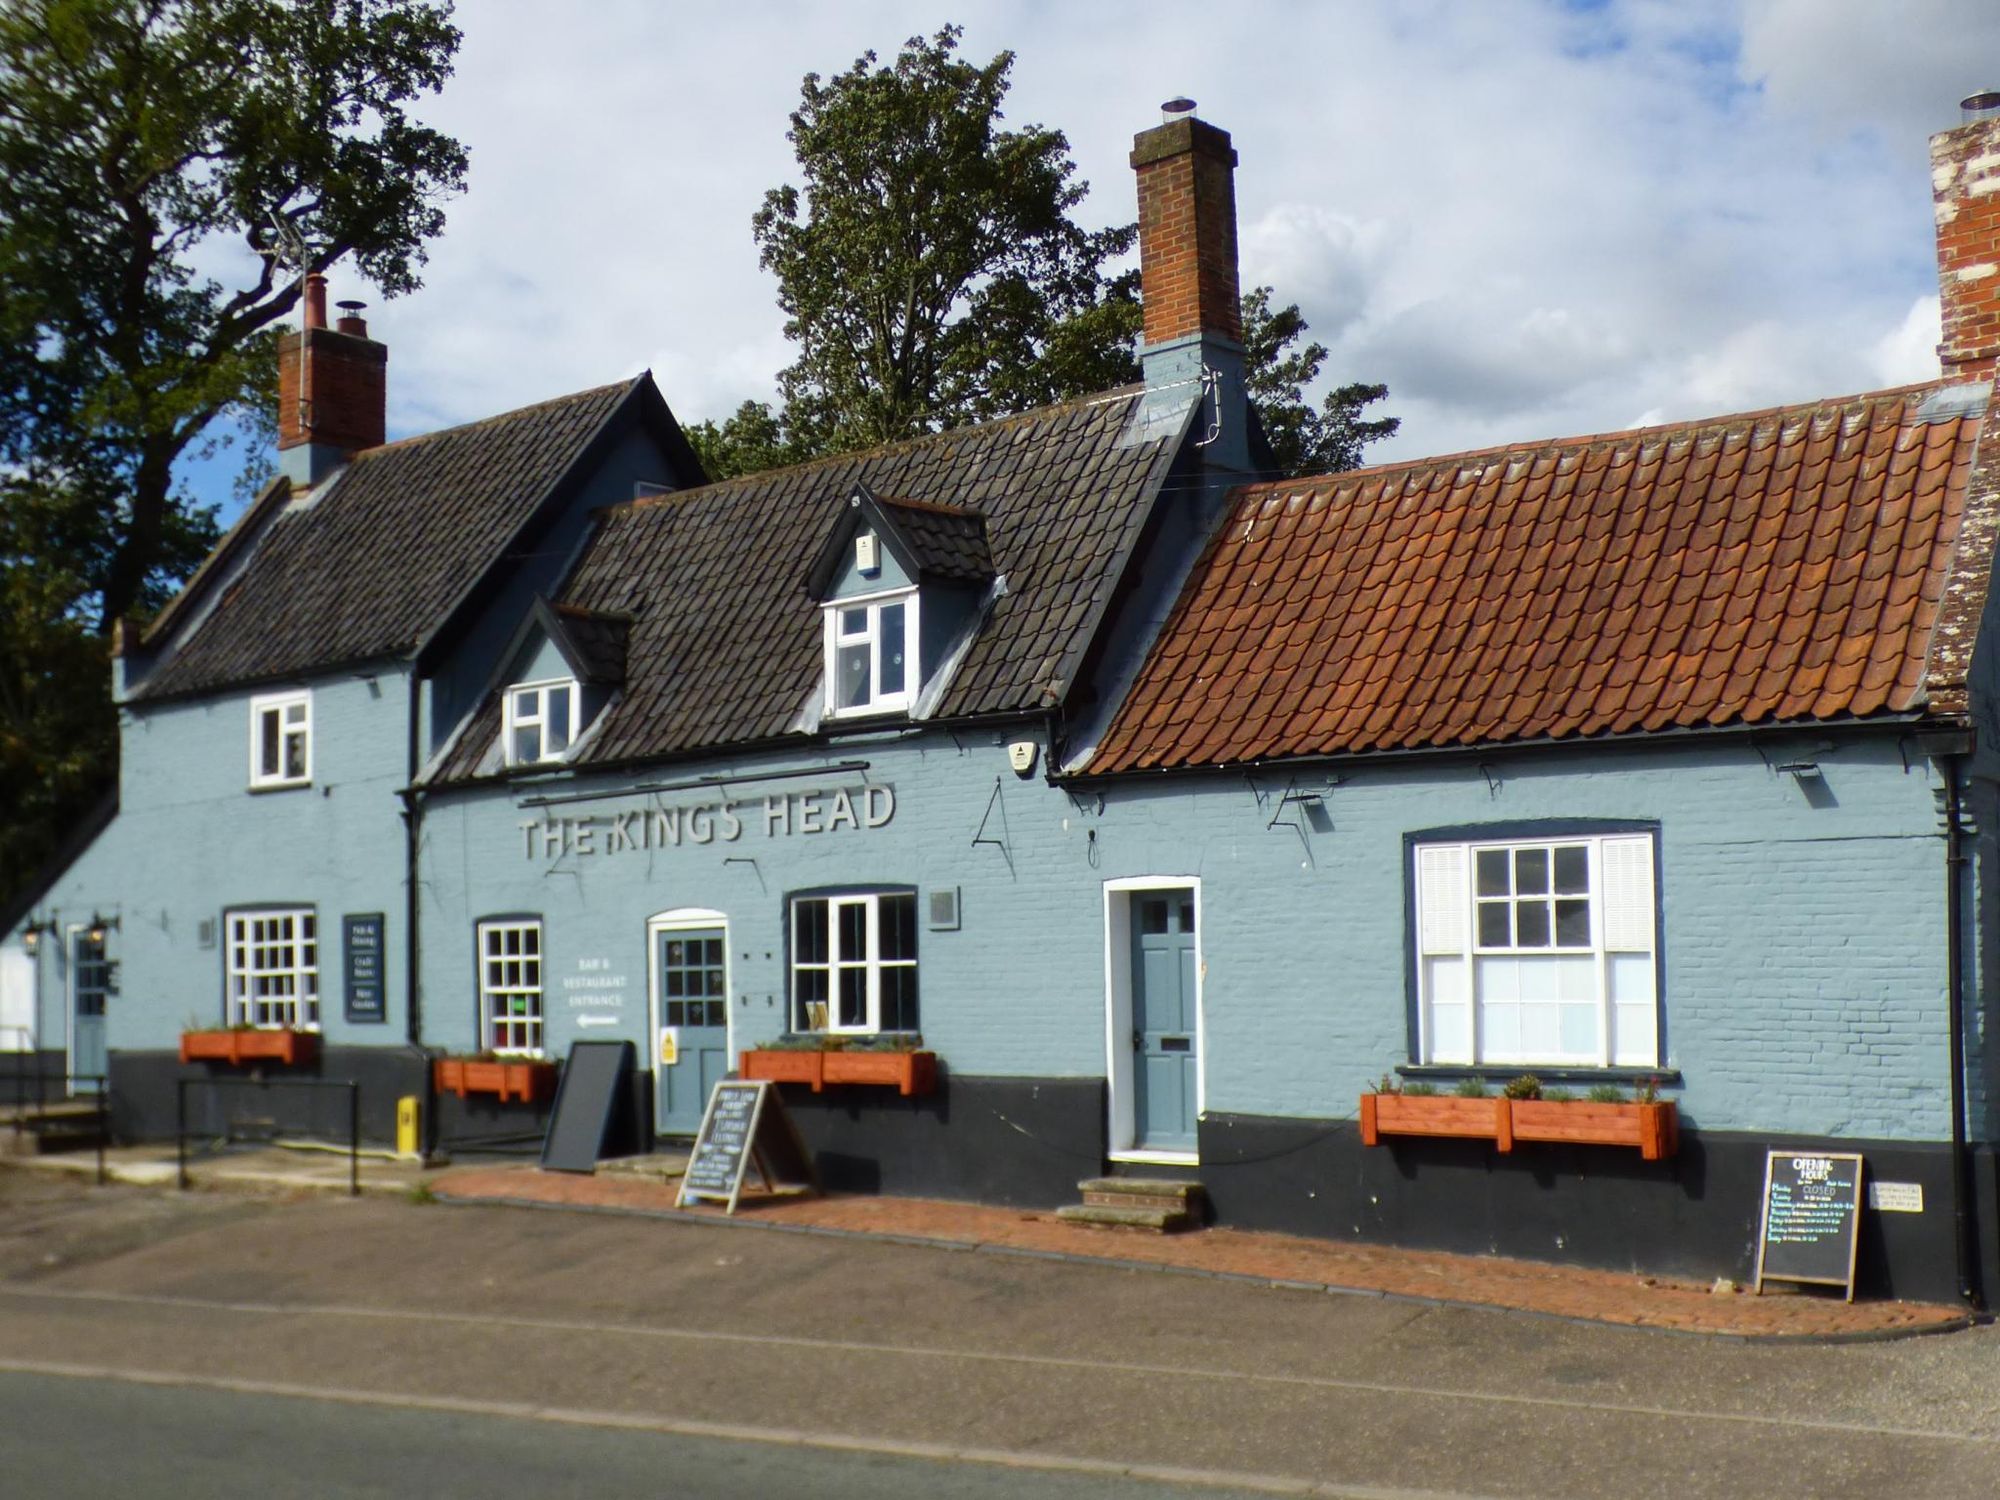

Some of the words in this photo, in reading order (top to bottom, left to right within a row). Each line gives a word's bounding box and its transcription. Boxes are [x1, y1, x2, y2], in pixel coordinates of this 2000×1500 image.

[518, 817, 595, 860] THE
[612, 800, 743, 851] KINGS
[763, 784, 896, 838] HEAD
[563, 976, 627, 988] RESTAURANT
[569, 994, 624, 1008] ENTRANCE
[1792, 1158, 1834, 1171] OPENING
[1800, 1170, 1829, 1181] HOURS
[1802, 1185, 1836, 1196] CLOSED
